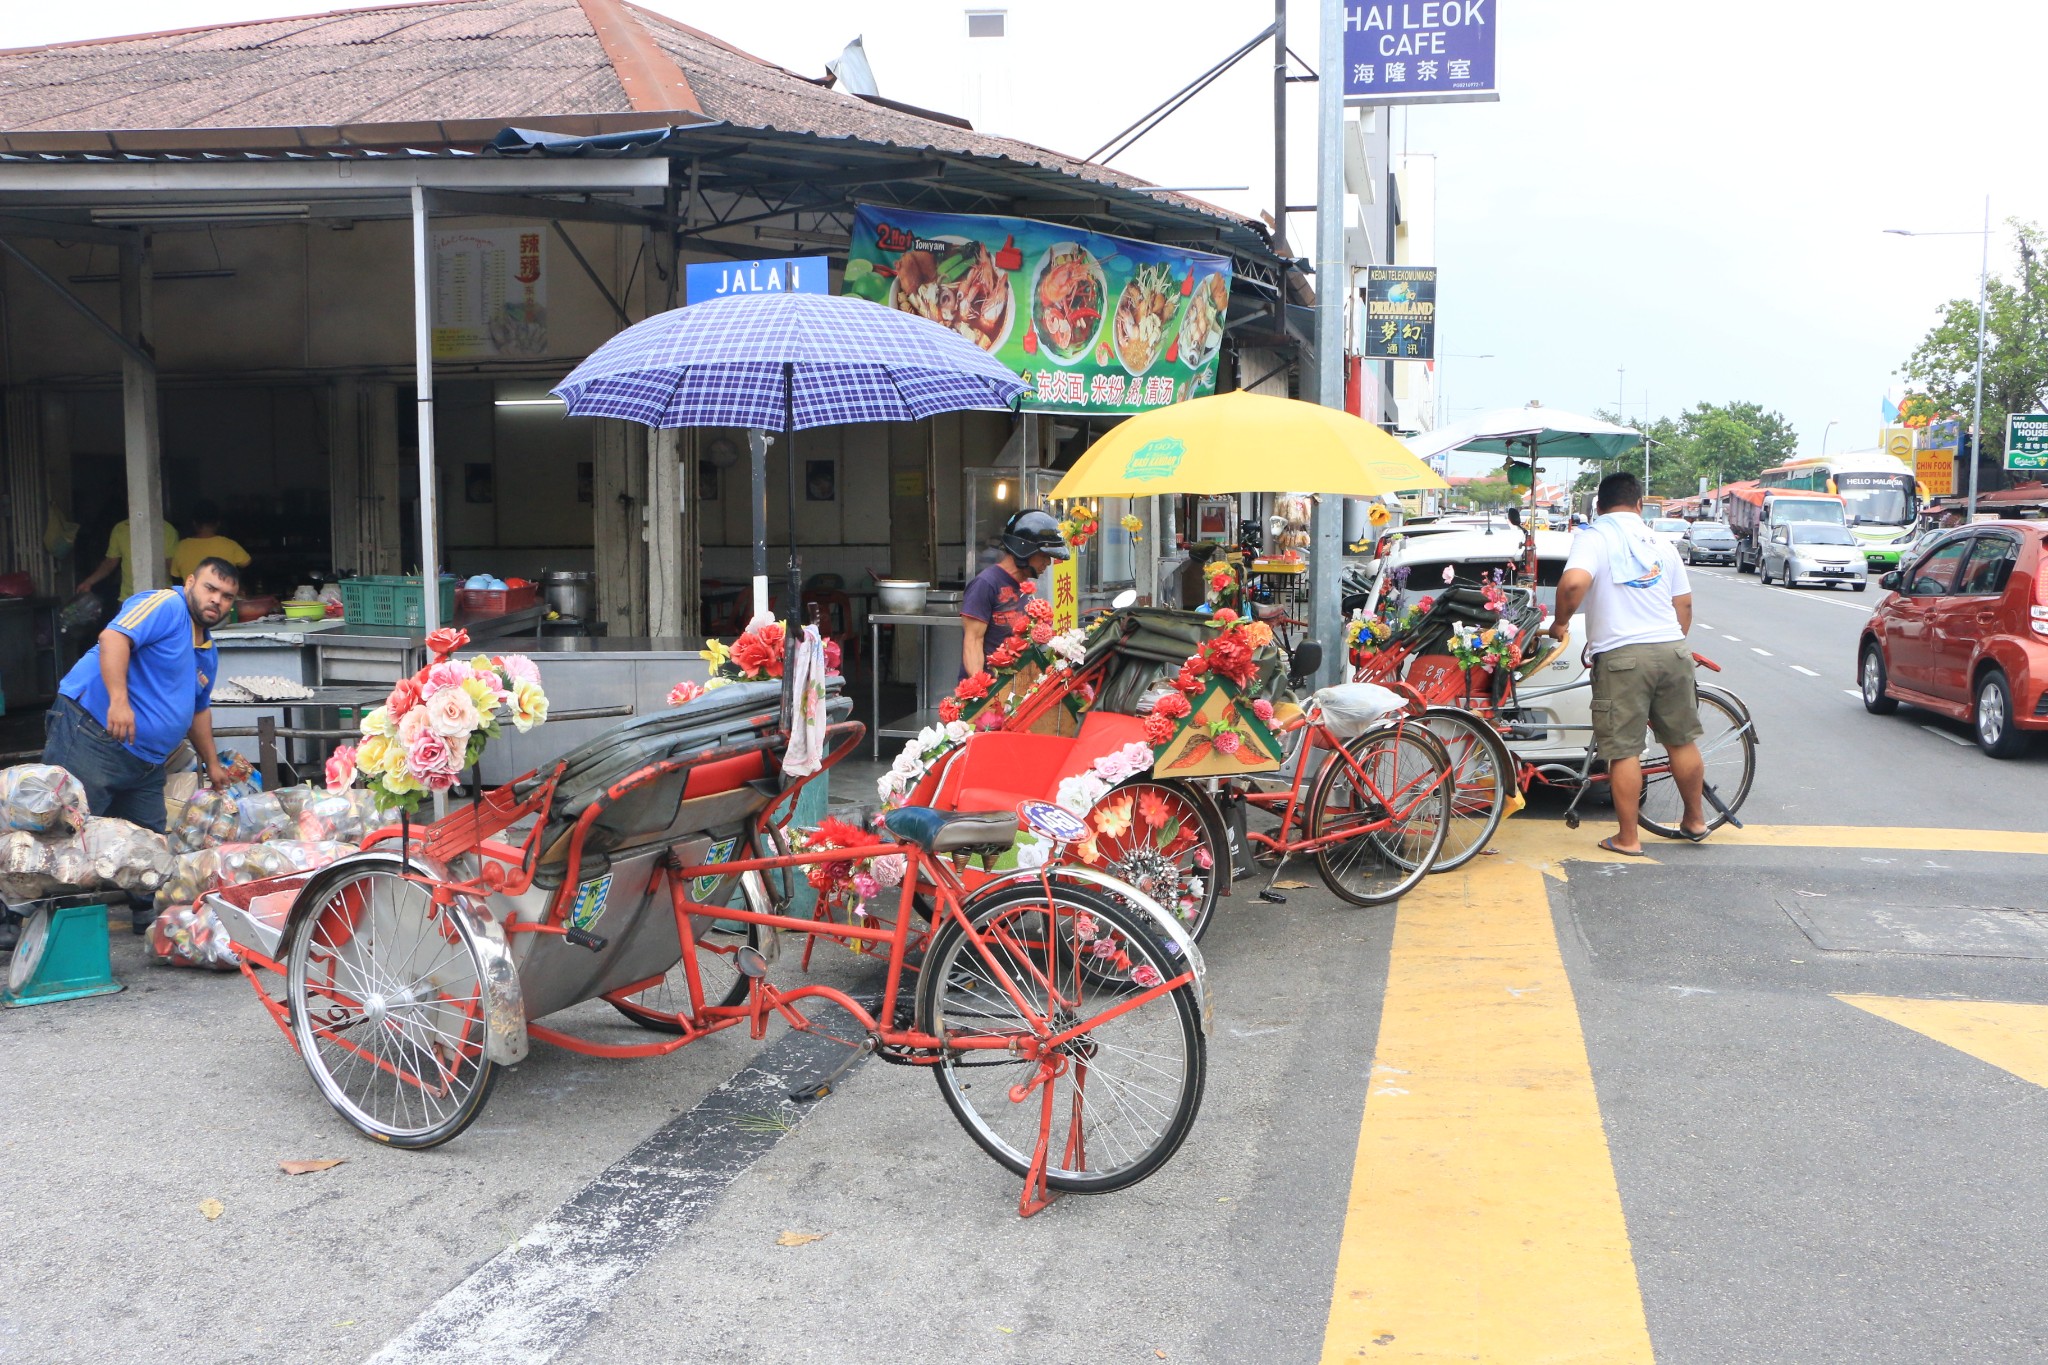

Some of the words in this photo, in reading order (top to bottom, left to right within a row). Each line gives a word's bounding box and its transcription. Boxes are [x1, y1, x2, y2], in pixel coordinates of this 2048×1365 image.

[1344, 5, 1393, 32] HAI
[1403, 0, 1485, 30] LEOK
[1379, 32, 1447, 57] CAFE
[1353, 58, 1471, 84] 海隆茶室
[915, 239, 945, 251] Tomyam
[715, 265, 800, 294] JALAN
[1371, 270, 1387, 280] KEDAI
[1388, 270, 1434, 281] TELEKOMUNIKASI
[1369, 301, 1433, 315] DREAMLAND
[1379, 321, 1421, 342] 梦幻
[1386, 343, 1418, 355] 通讯
[2017, 429, 2048, 437] HOUSE
[1916, 461, 1932, 470] CHIN
[1933, 461, 1952, 470] FOOK
[1872, 478, 1903, 488] MALAYSIA
